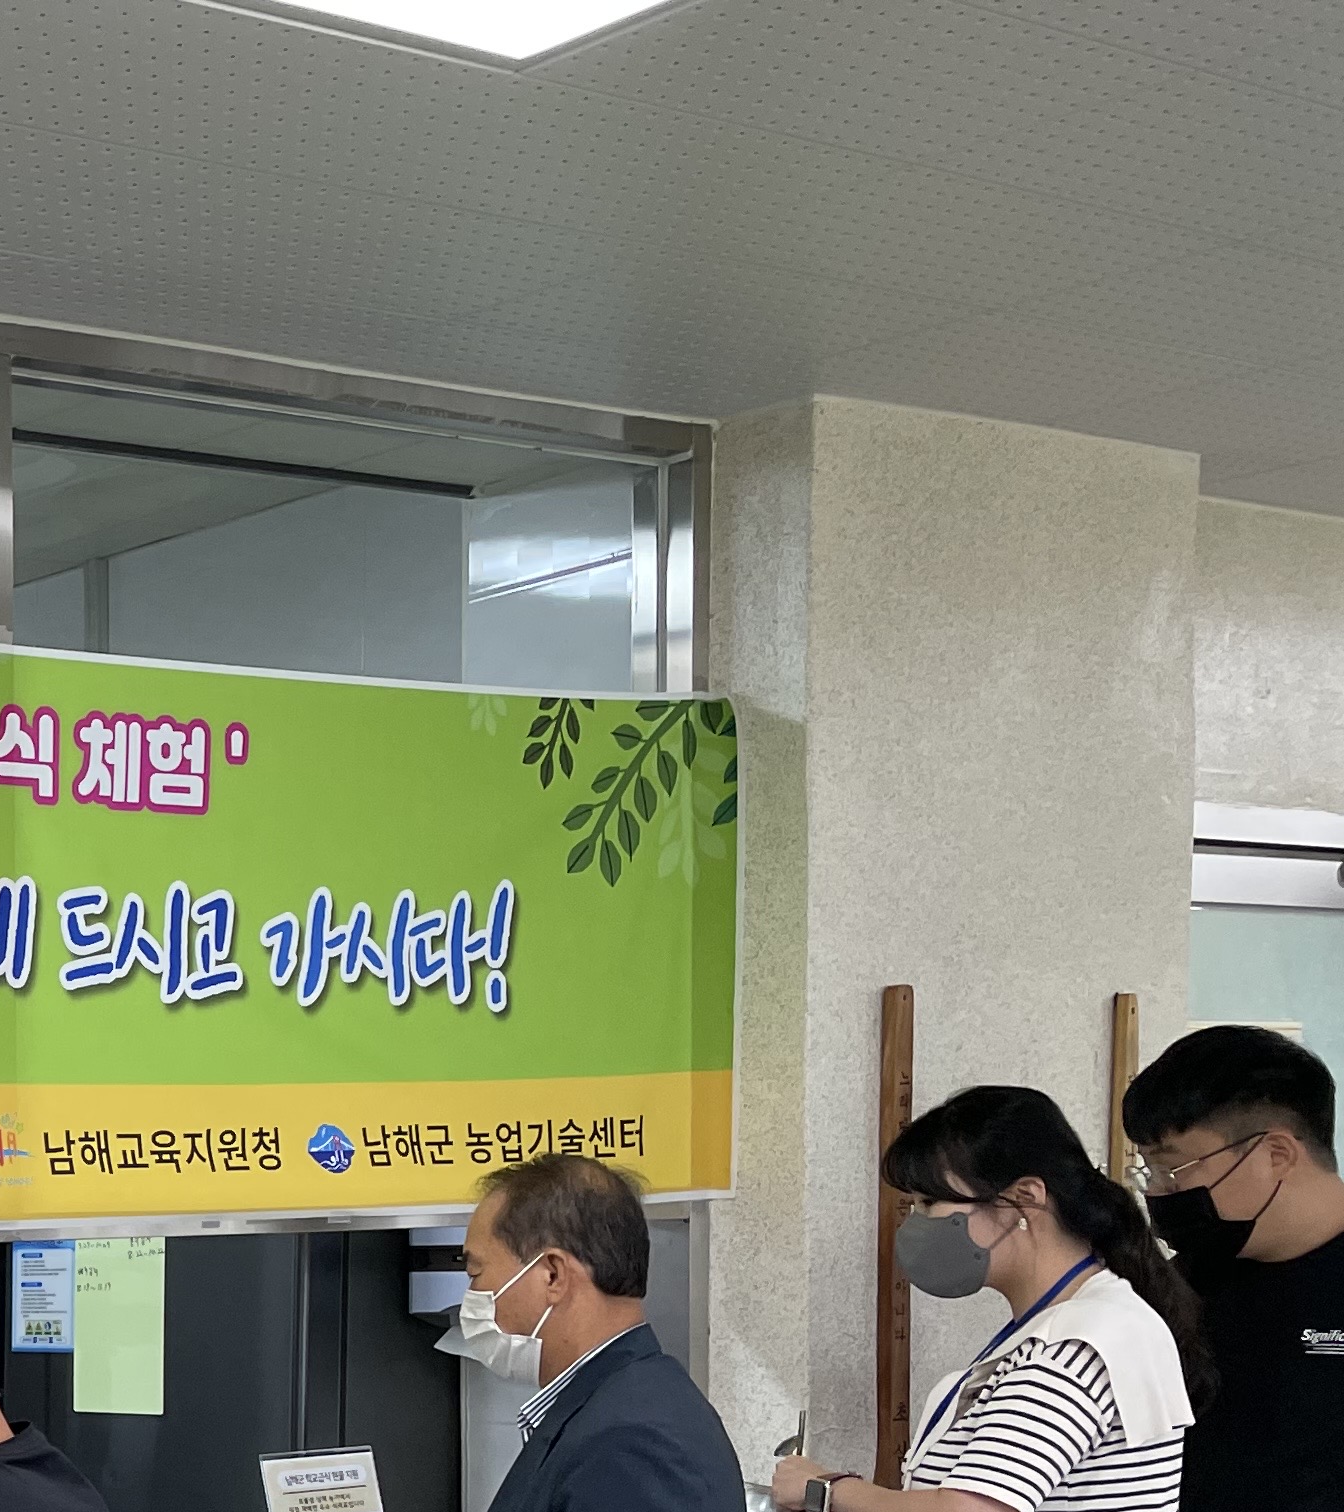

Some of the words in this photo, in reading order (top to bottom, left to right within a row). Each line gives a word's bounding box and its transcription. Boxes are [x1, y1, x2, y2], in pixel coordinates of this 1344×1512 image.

[72, 710, 210, 815] 체험
[57, 880, 243, 1004] 드시고
[259, 879, 515, 1013] 가시다!
[43, 1125, 282, 1176] 남해교육지원청
[362, 1123, 454, 1167] 남해군
[465, 1115, 644, 1164] 농업기술센터
